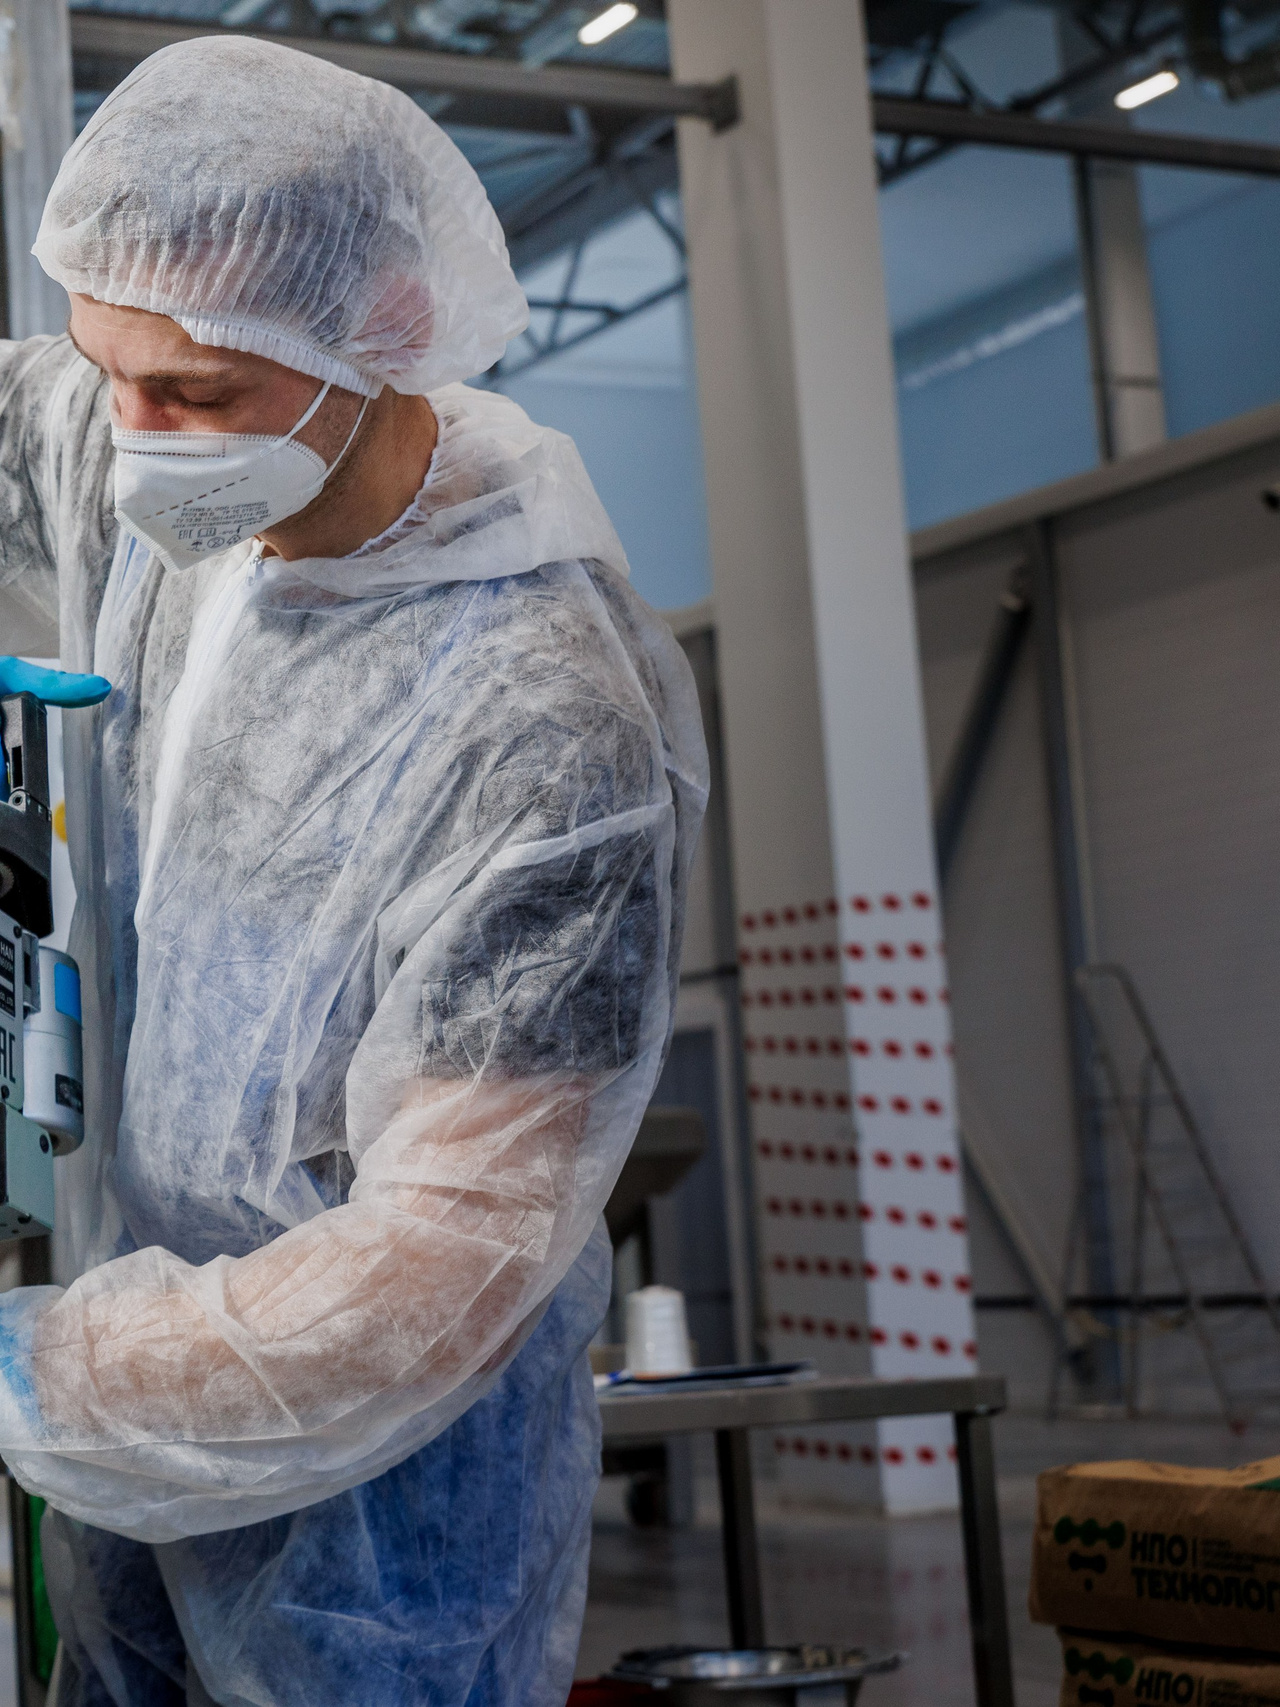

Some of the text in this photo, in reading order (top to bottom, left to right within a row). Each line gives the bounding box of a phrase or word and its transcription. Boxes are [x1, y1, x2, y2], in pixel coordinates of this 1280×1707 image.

[0, 941, 14, 962] HAN
[1130, 1532, 1188, 1566] НПО
[1130, 1567, 1280, 1613] ТЕХНОЛОГ
[1134, 1668, 1194, 1703] НПО
